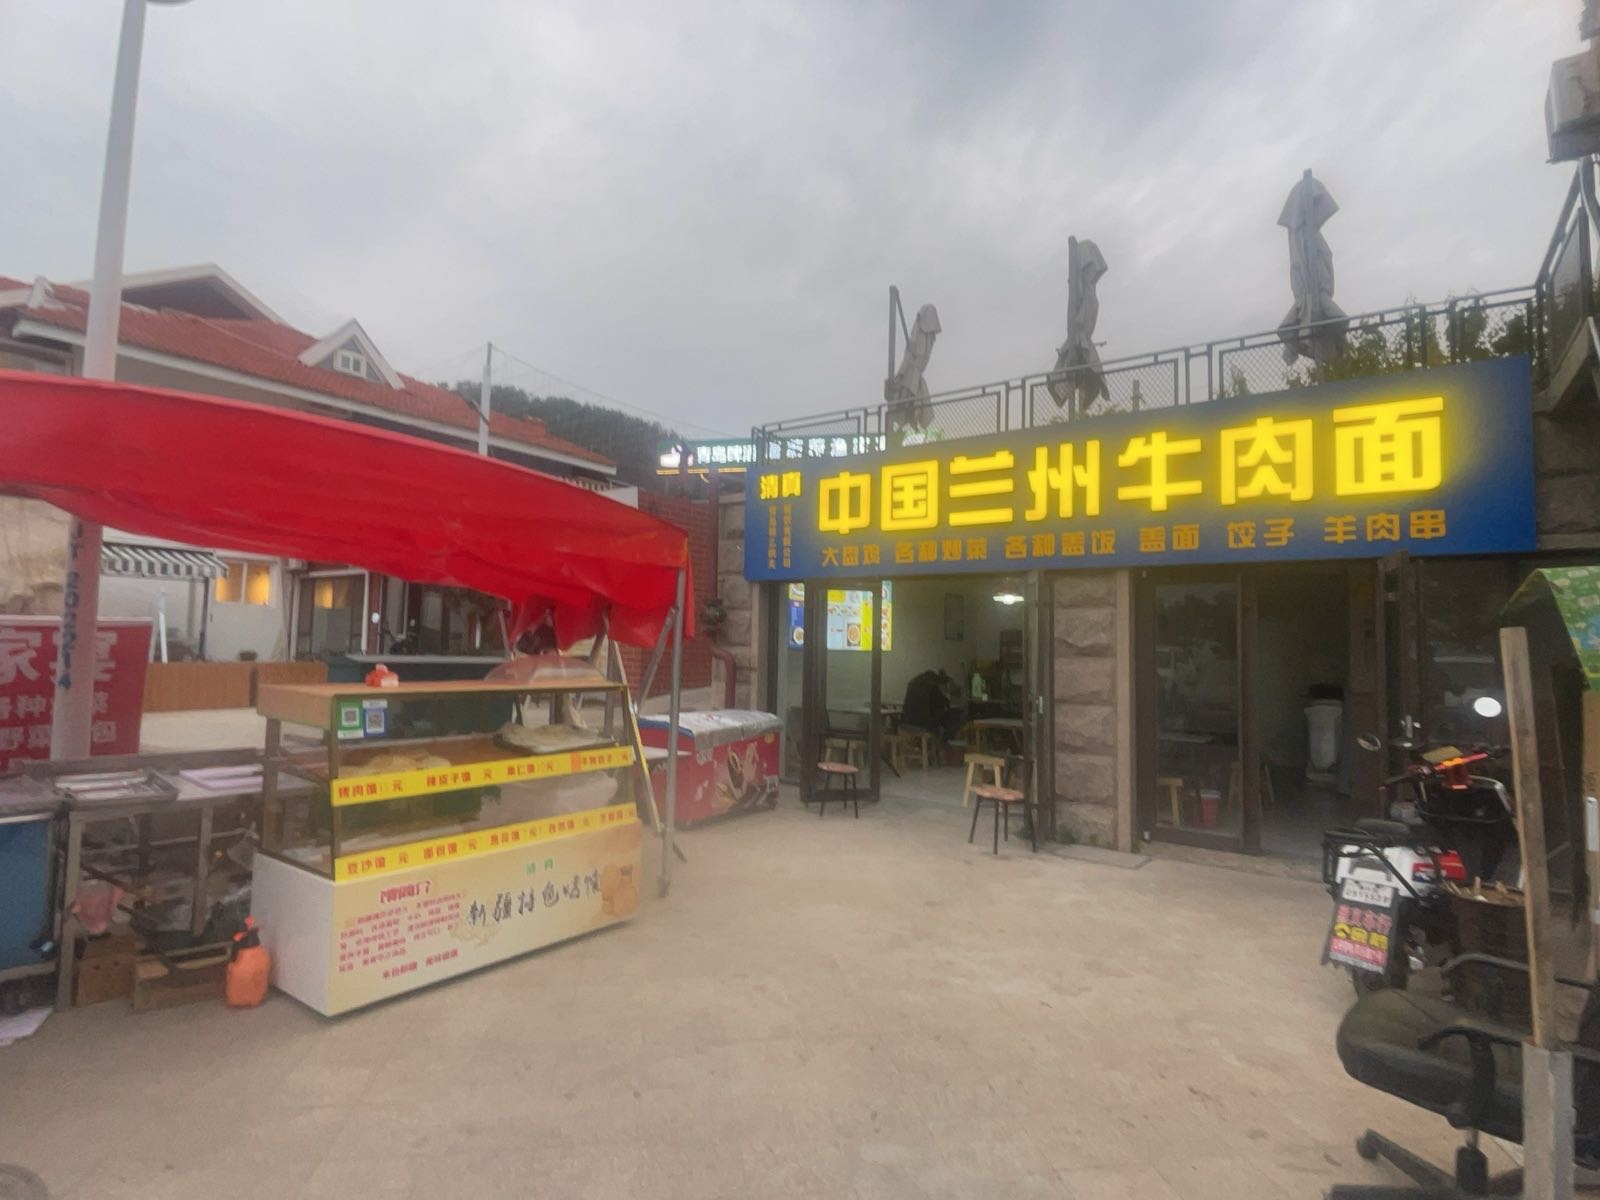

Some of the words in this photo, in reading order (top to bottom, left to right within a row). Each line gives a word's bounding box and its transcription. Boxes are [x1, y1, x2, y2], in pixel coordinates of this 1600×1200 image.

[818, 397, 1444, 534] 中国兰州牛肉面
[895, 537, 988, 564] 各种炒菜
[1004, 529, 1117, 560] 各种盖饭
[1227, 518, 1296, 549] 饺子
[1324, 510, 1446, 543] 羊肉串
